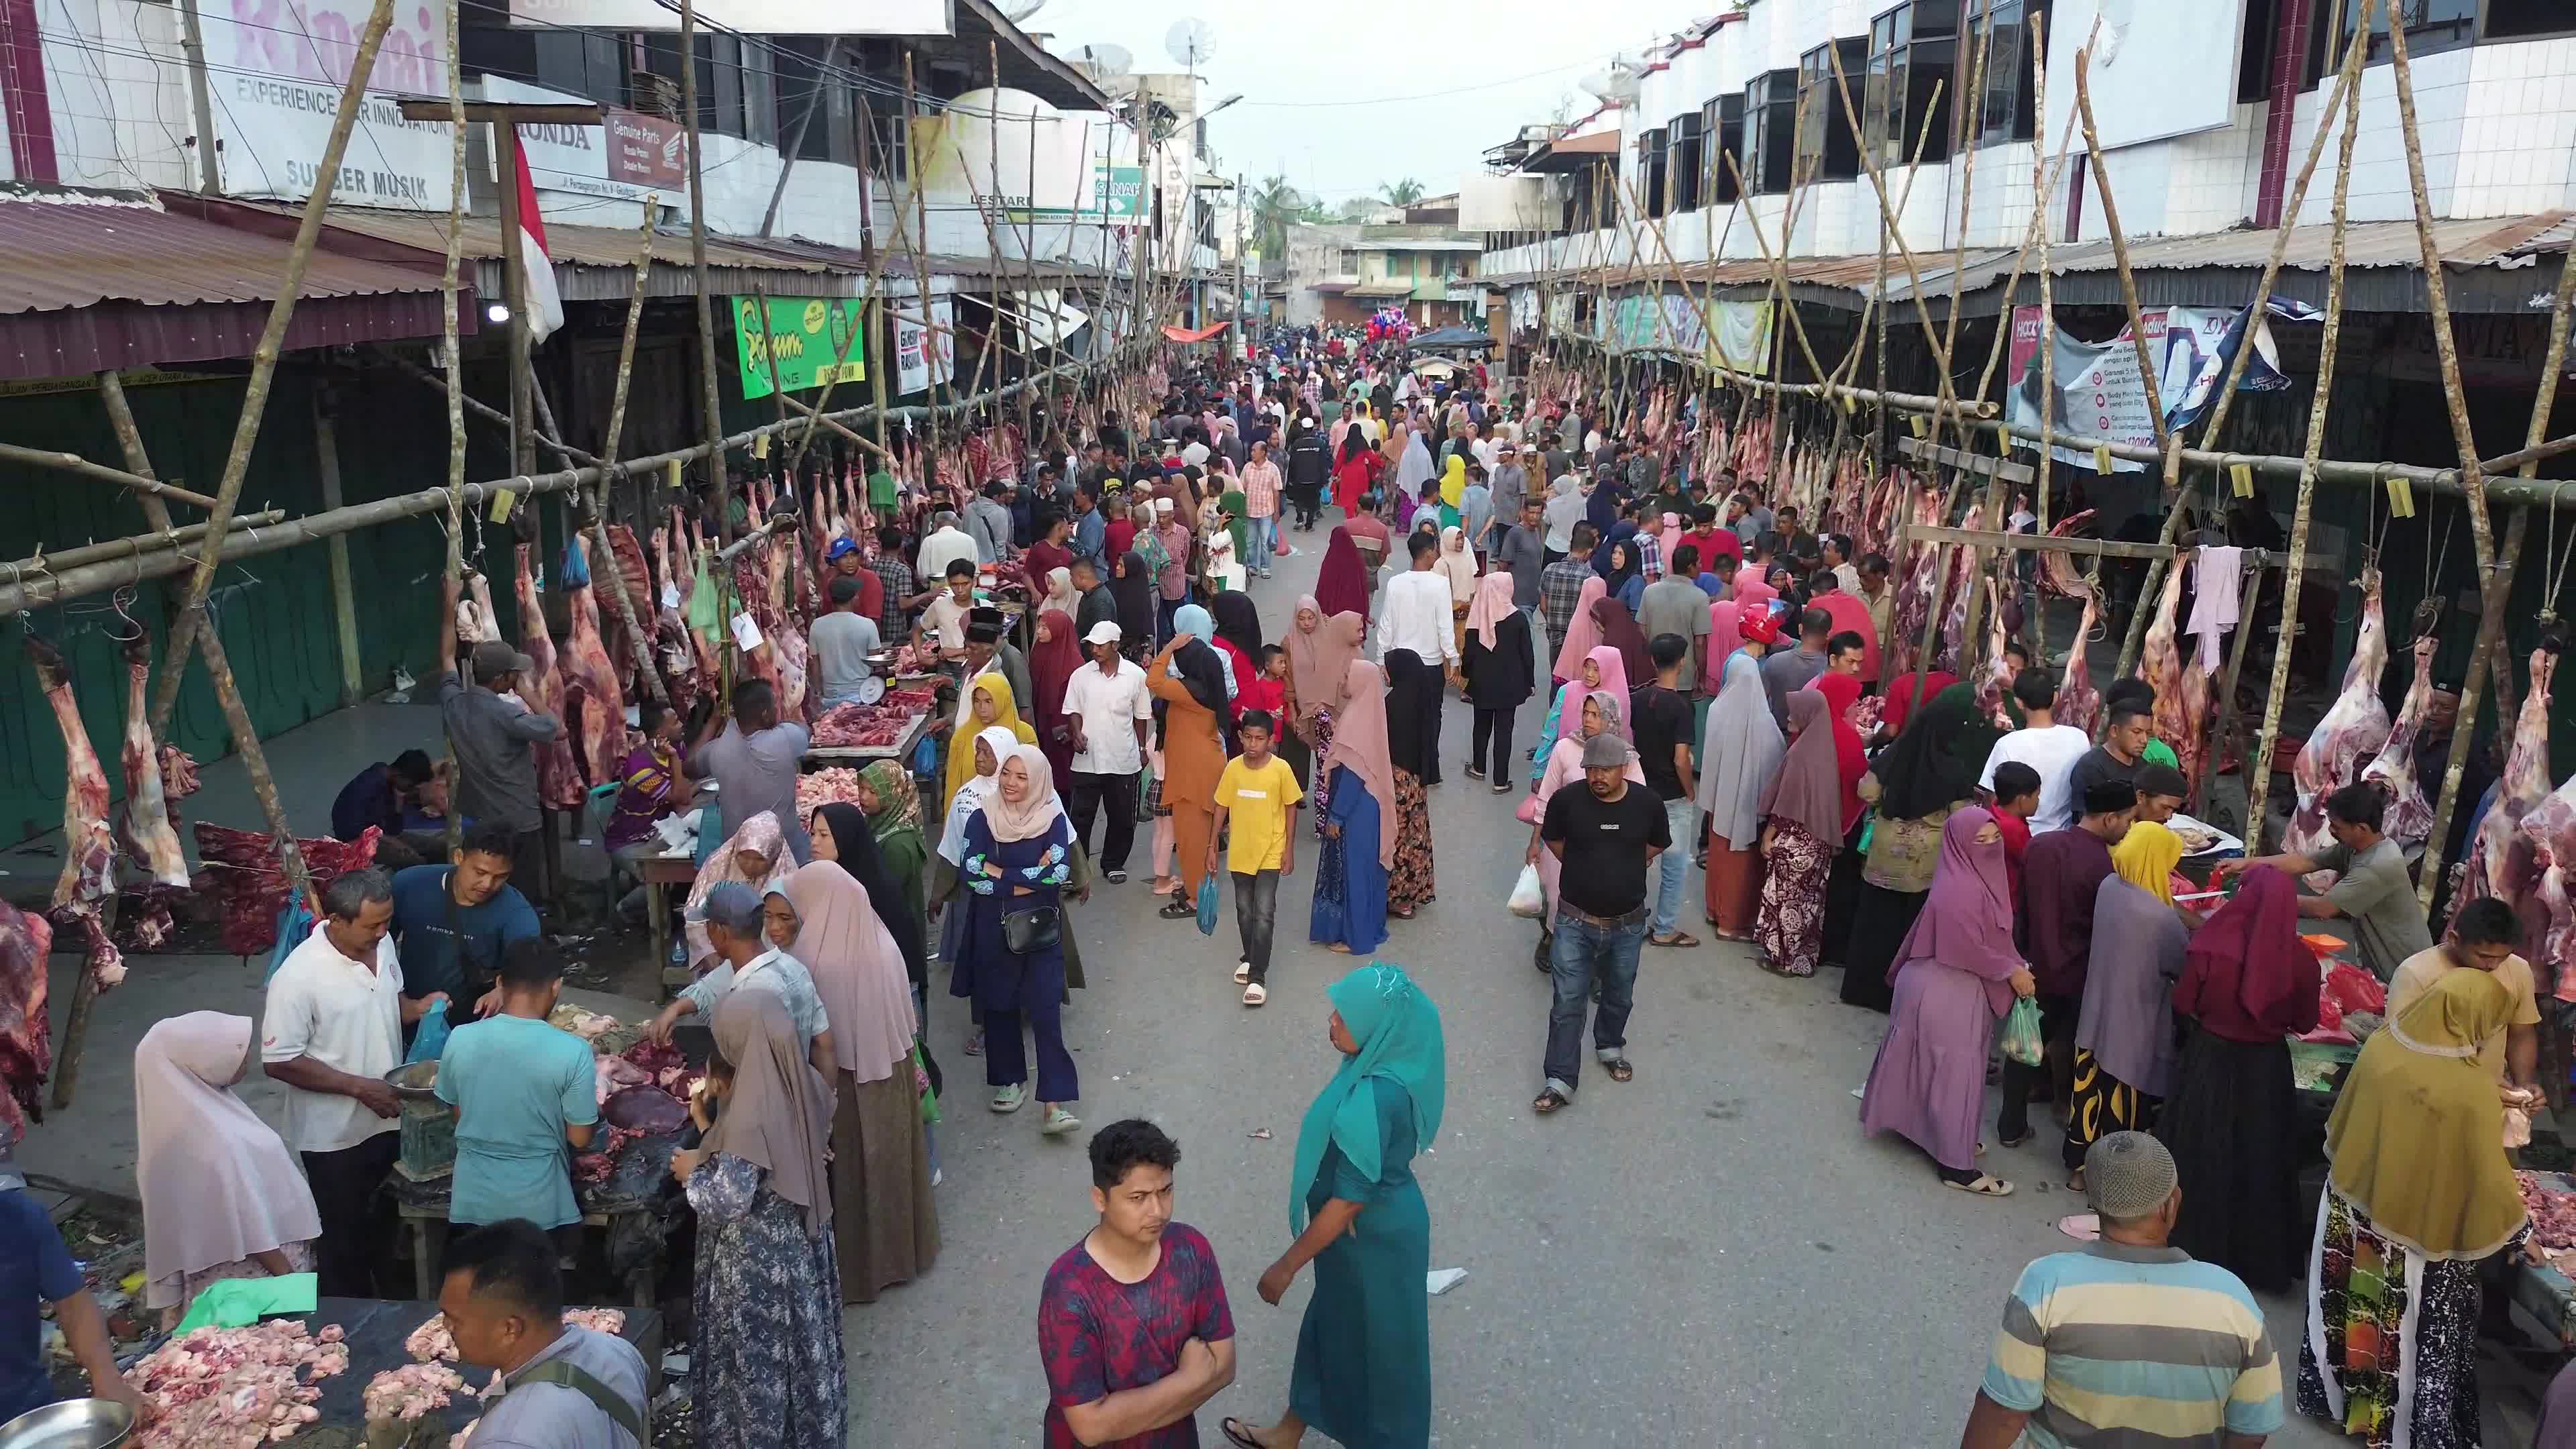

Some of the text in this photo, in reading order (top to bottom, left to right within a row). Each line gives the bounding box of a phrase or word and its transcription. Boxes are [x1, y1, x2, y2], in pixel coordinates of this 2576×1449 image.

[237, 77, 336, 116] EXPERIENCE
[614, 120, 660, 145] Genuine Parts
[286, 160, 428, 200] SUBER MUSIK
